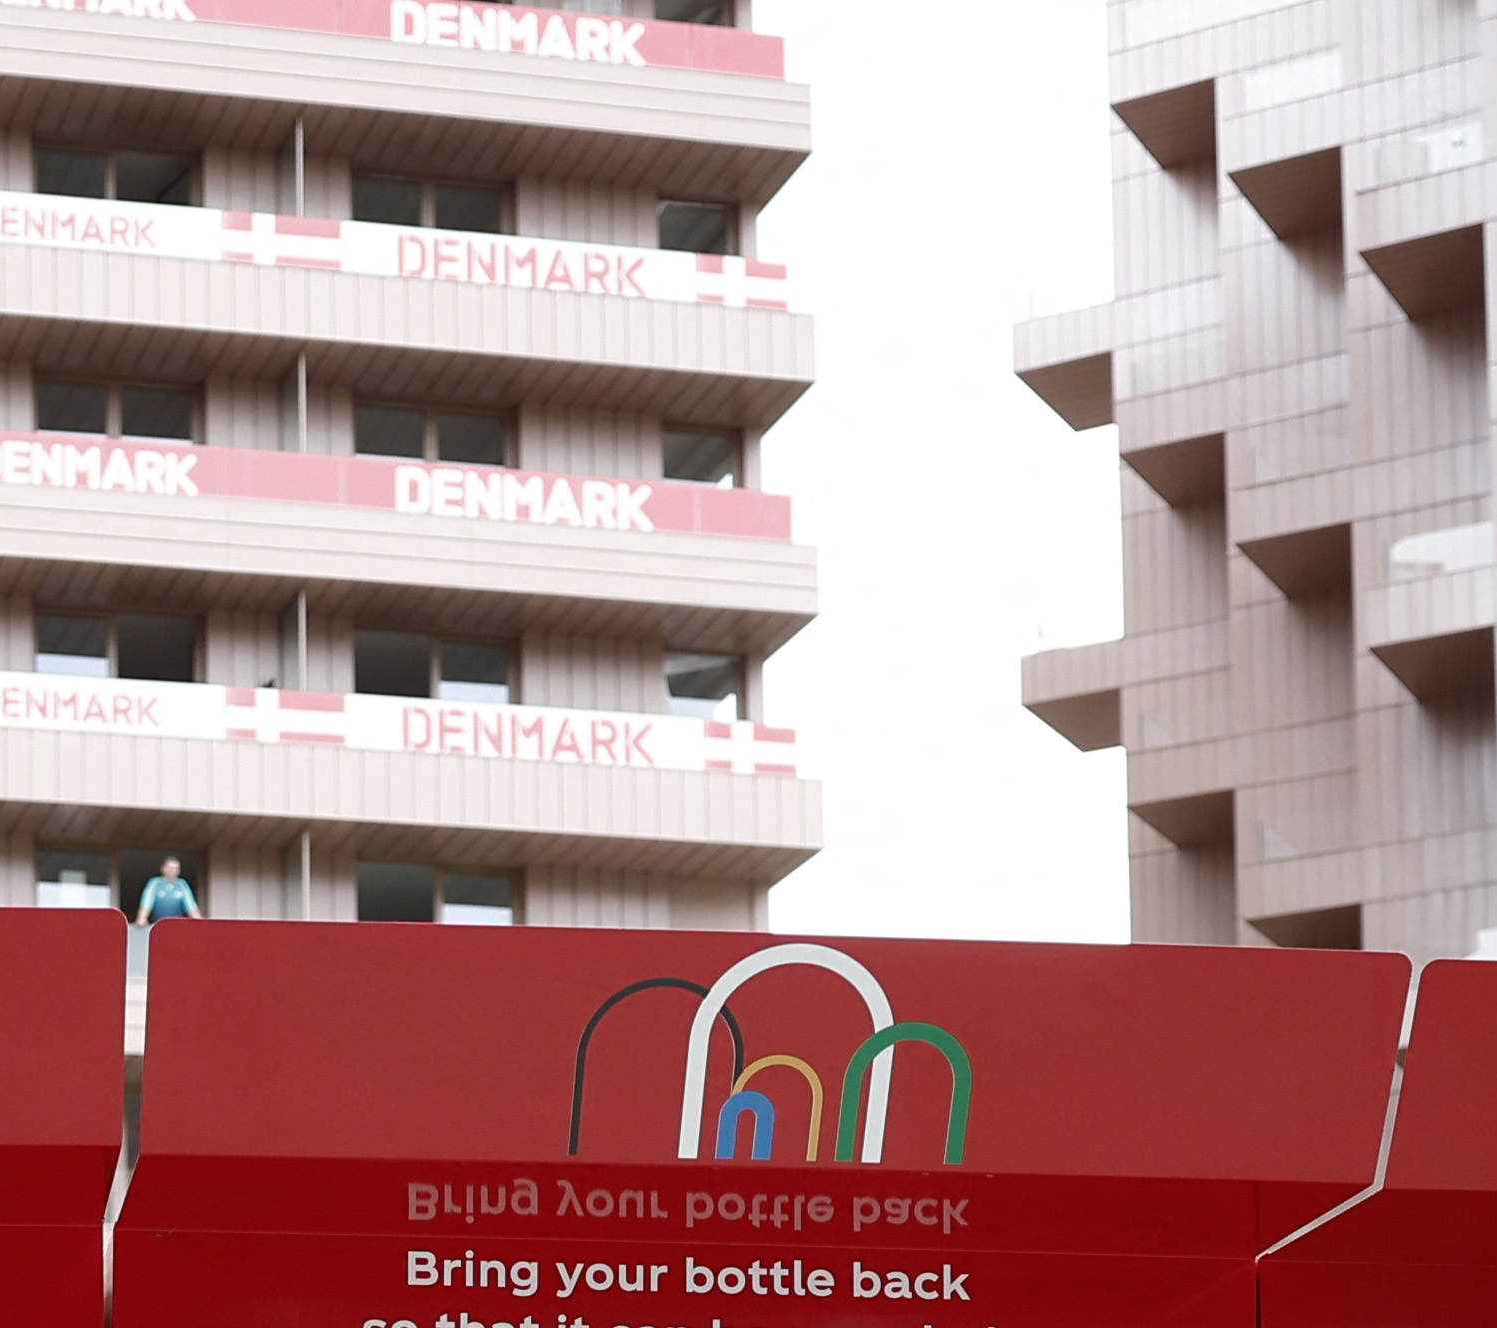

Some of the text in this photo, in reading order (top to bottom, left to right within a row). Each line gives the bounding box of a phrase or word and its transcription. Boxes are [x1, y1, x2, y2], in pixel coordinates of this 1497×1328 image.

[390, 2, 648, 67] DENMARK
[397, 234, 647, 298] DENMARK
[395, 464, 655, 532] DENMARK
[404, 706, 655, 768] DENMARK
[407, 1249, 971, 1301] Bring your bottle back
